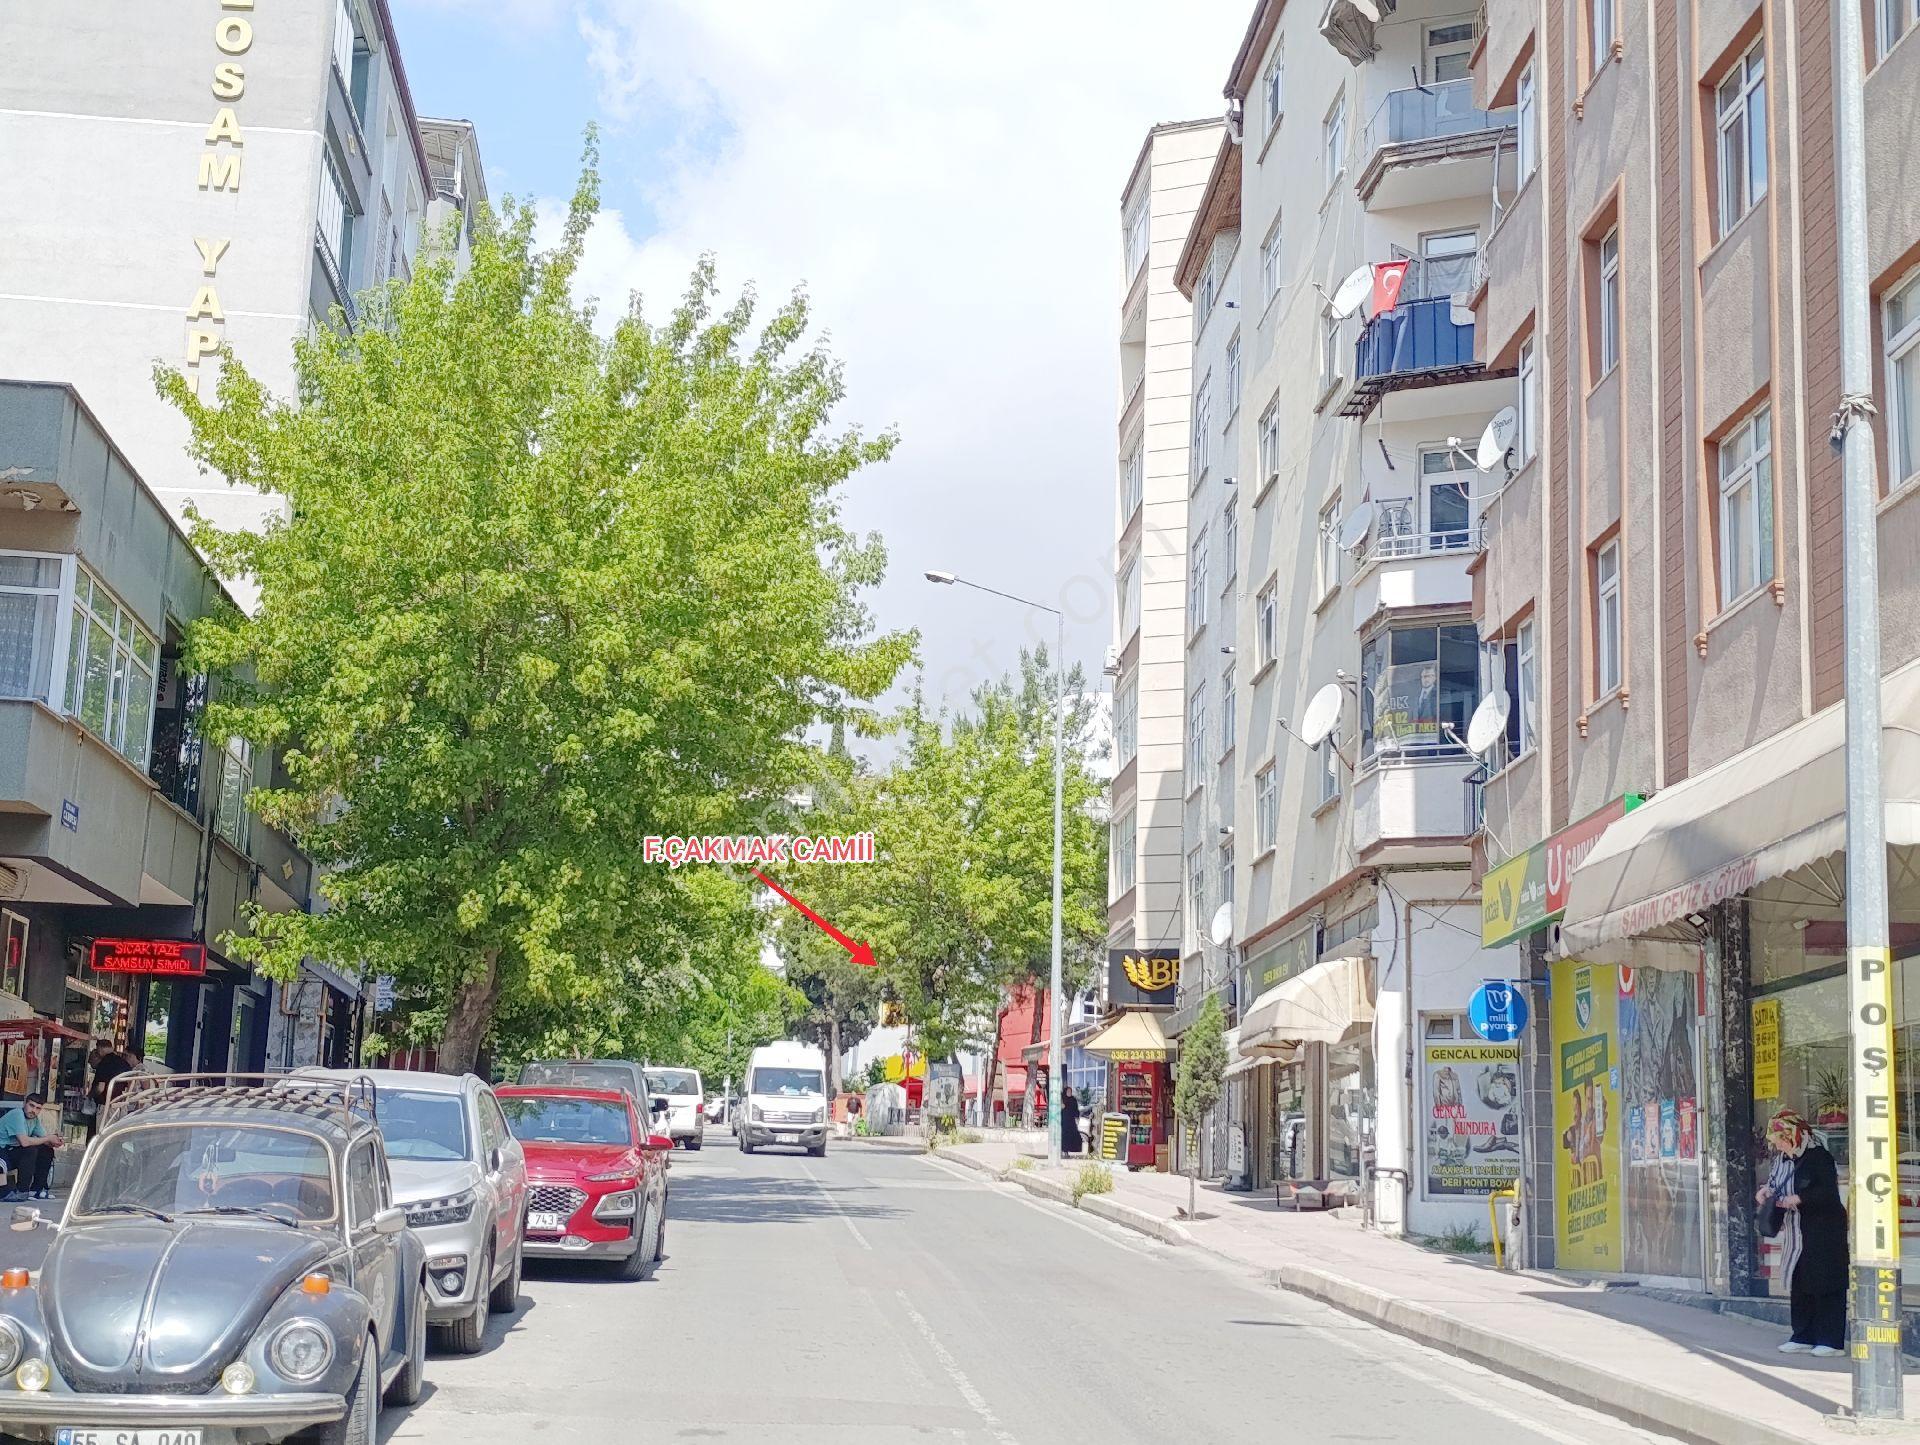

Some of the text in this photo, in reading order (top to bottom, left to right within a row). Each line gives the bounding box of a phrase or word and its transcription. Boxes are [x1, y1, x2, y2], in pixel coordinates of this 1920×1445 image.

[197, 0, 254, 193] OSAM
[1565, 832, 1602, 884] GANY
[1432, 1049, 1477, 1060] GENCAL
[1859, 958, 1892, 1250] POŞETÇİ
[1454, 1120, 1497, 1136] KUNDURA
[1441, 1177, 1462, 1187] DERİ
[535, 1214, 554, 1225] 743
[1878, 1268, 1896, 1319] KOLİ
